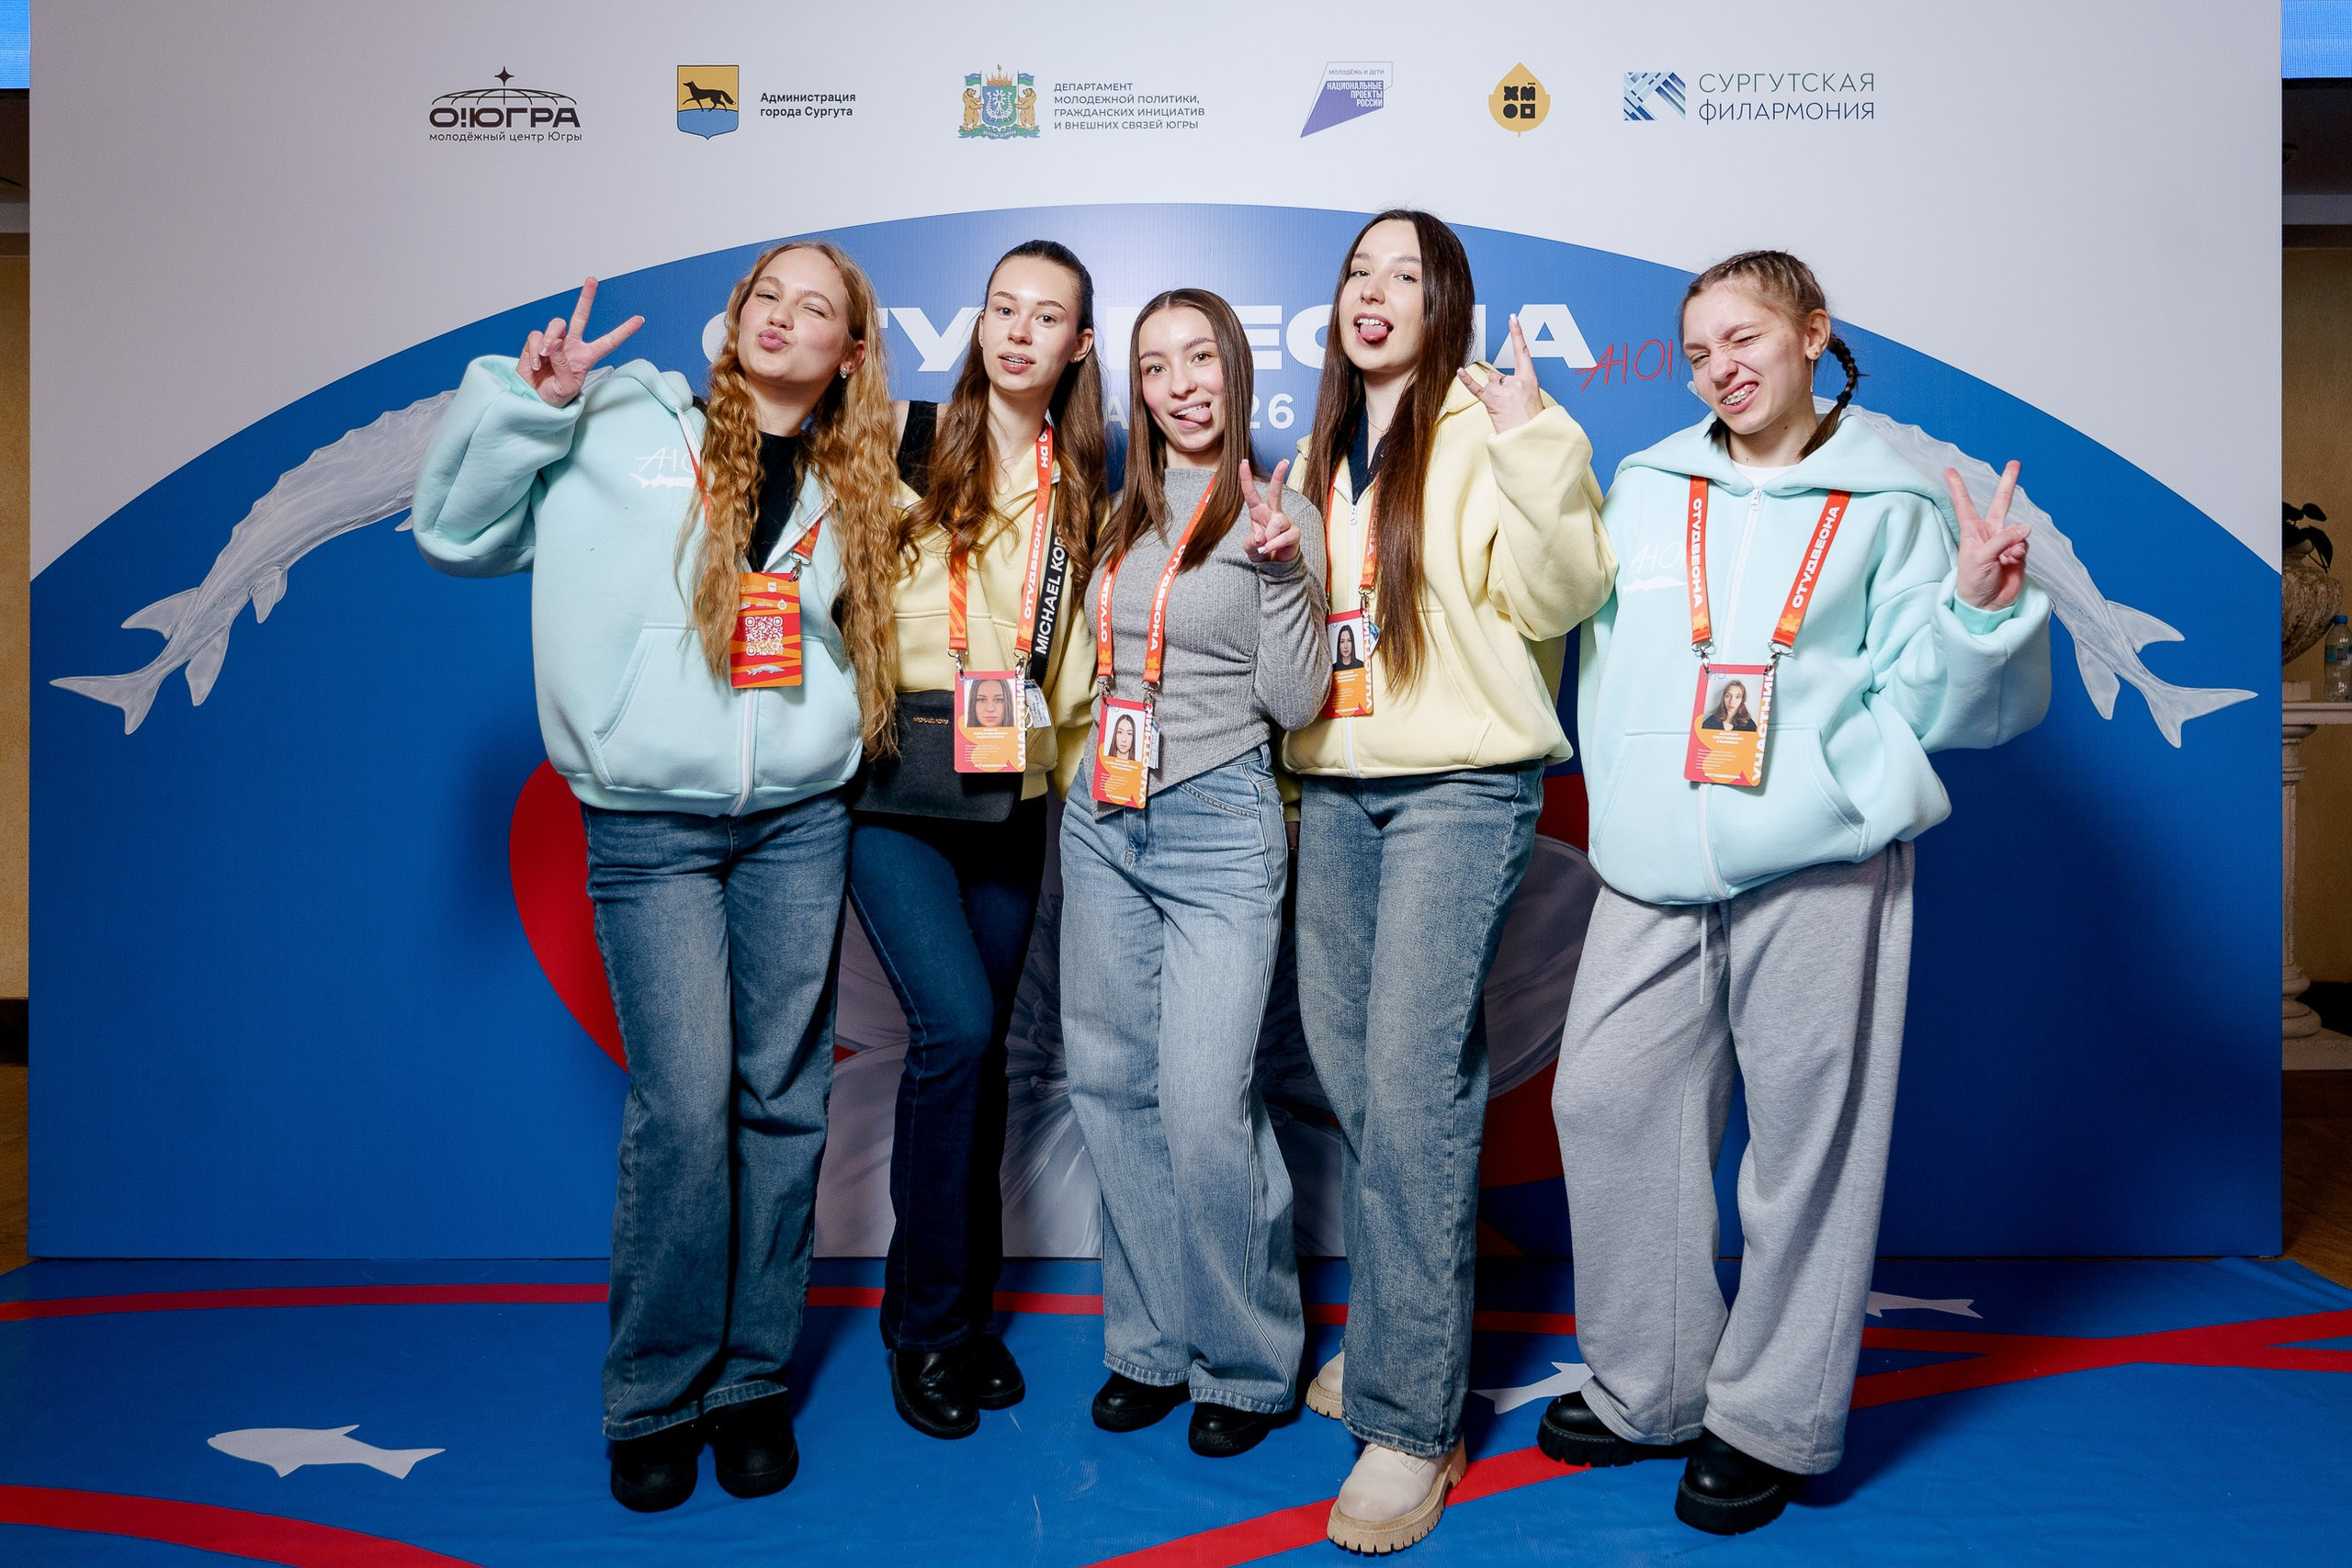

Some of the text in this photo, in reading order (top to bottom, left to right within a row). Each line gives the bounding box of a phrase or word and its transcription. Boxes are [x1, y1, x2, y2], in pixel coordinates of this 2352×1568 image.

[1054, 83, 1134, 93] ДЕПАРТАМЕНТ
[1327, 81, 1383, 91] НАЦИОНАЛЬНЫЕ
[1699, 73, 1874, 93] СУРГУТСКАЯ
[760, 92, 856, 105] Администрация
[1054, 94, 1200, 105] МОЛОДЕЖНОЙ ПОЛИТИКИ,
[1351, 90, 1383, 99] ПРОЕКТЫ
[1356, 98, 1383, 107] РОССИИ
[429, 107, 581, 128] О!ЮГРА
[760, 106, 854, 119] города Сургута
[1054, 107, 1205, 118] ГРАЖДАНСКИХ ИНИЦИАТИВ
[1699, 98, 1874, 125] ФИЛАРМОНИЯ
[1065, 121, 1119, 130] ВНЕШНИХ
[1122, 119, 1164, 130] СВЯЗЕЙ
[1166, 120, 1199, 130] ЮГРЫ
[429, 130, 583, 143] молодёжный центр Югры
[1035, 576, 1062, 655] MICHAEL
[1751, 668, 1775, 782] УЧАСТНИК
